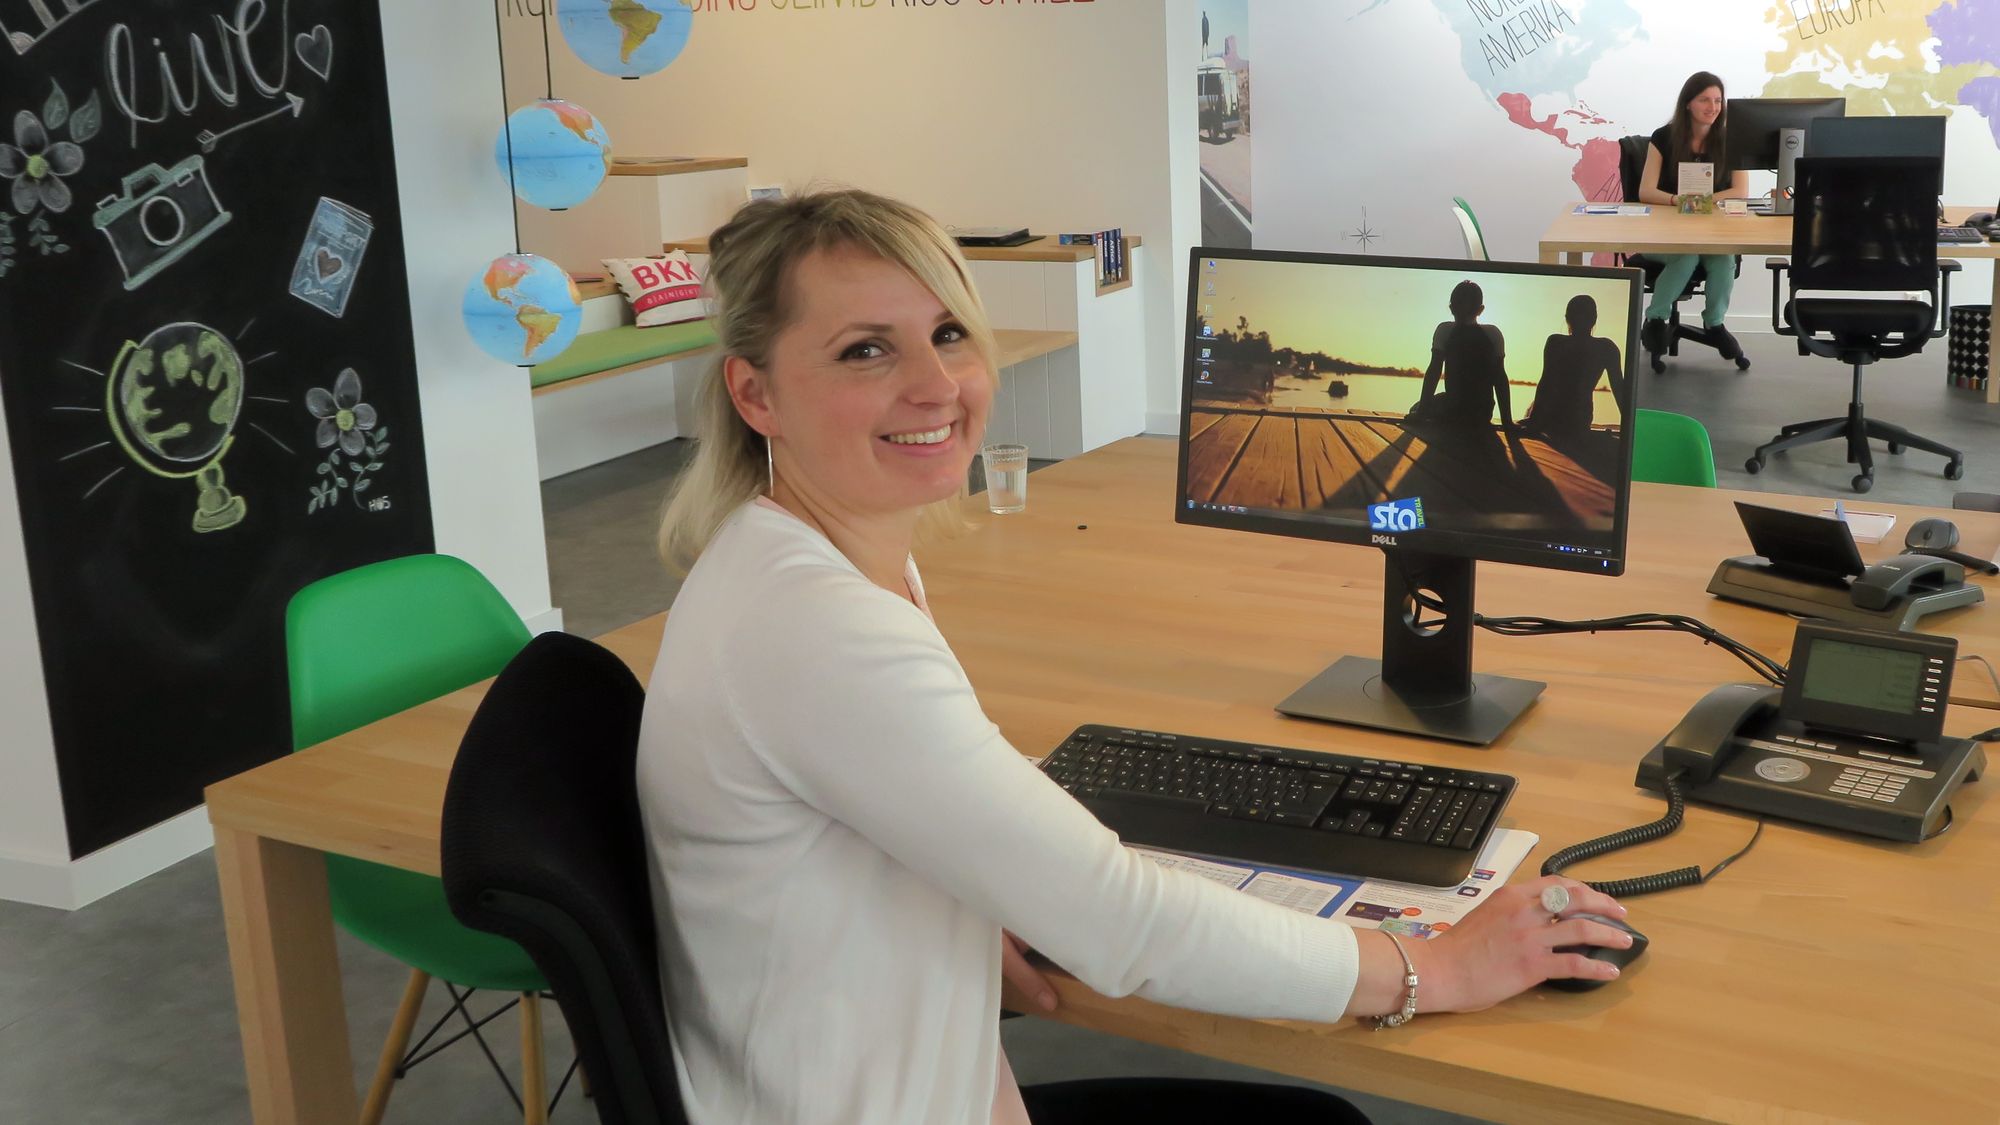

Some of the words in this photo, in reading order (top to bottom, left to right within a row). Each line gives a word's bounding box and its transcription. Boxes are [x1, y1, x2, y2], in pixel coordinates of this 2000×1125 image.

[1479, 0, 1576, 76] AMERIKA
[107, 0, 289, 148] live
[631, 260, 702, 290] BKK
[1373, 502, 1417, 531] sta
[1414, 497, 1425, 527] TRAVEL
[1372, 534, 1397, 545] DELL
